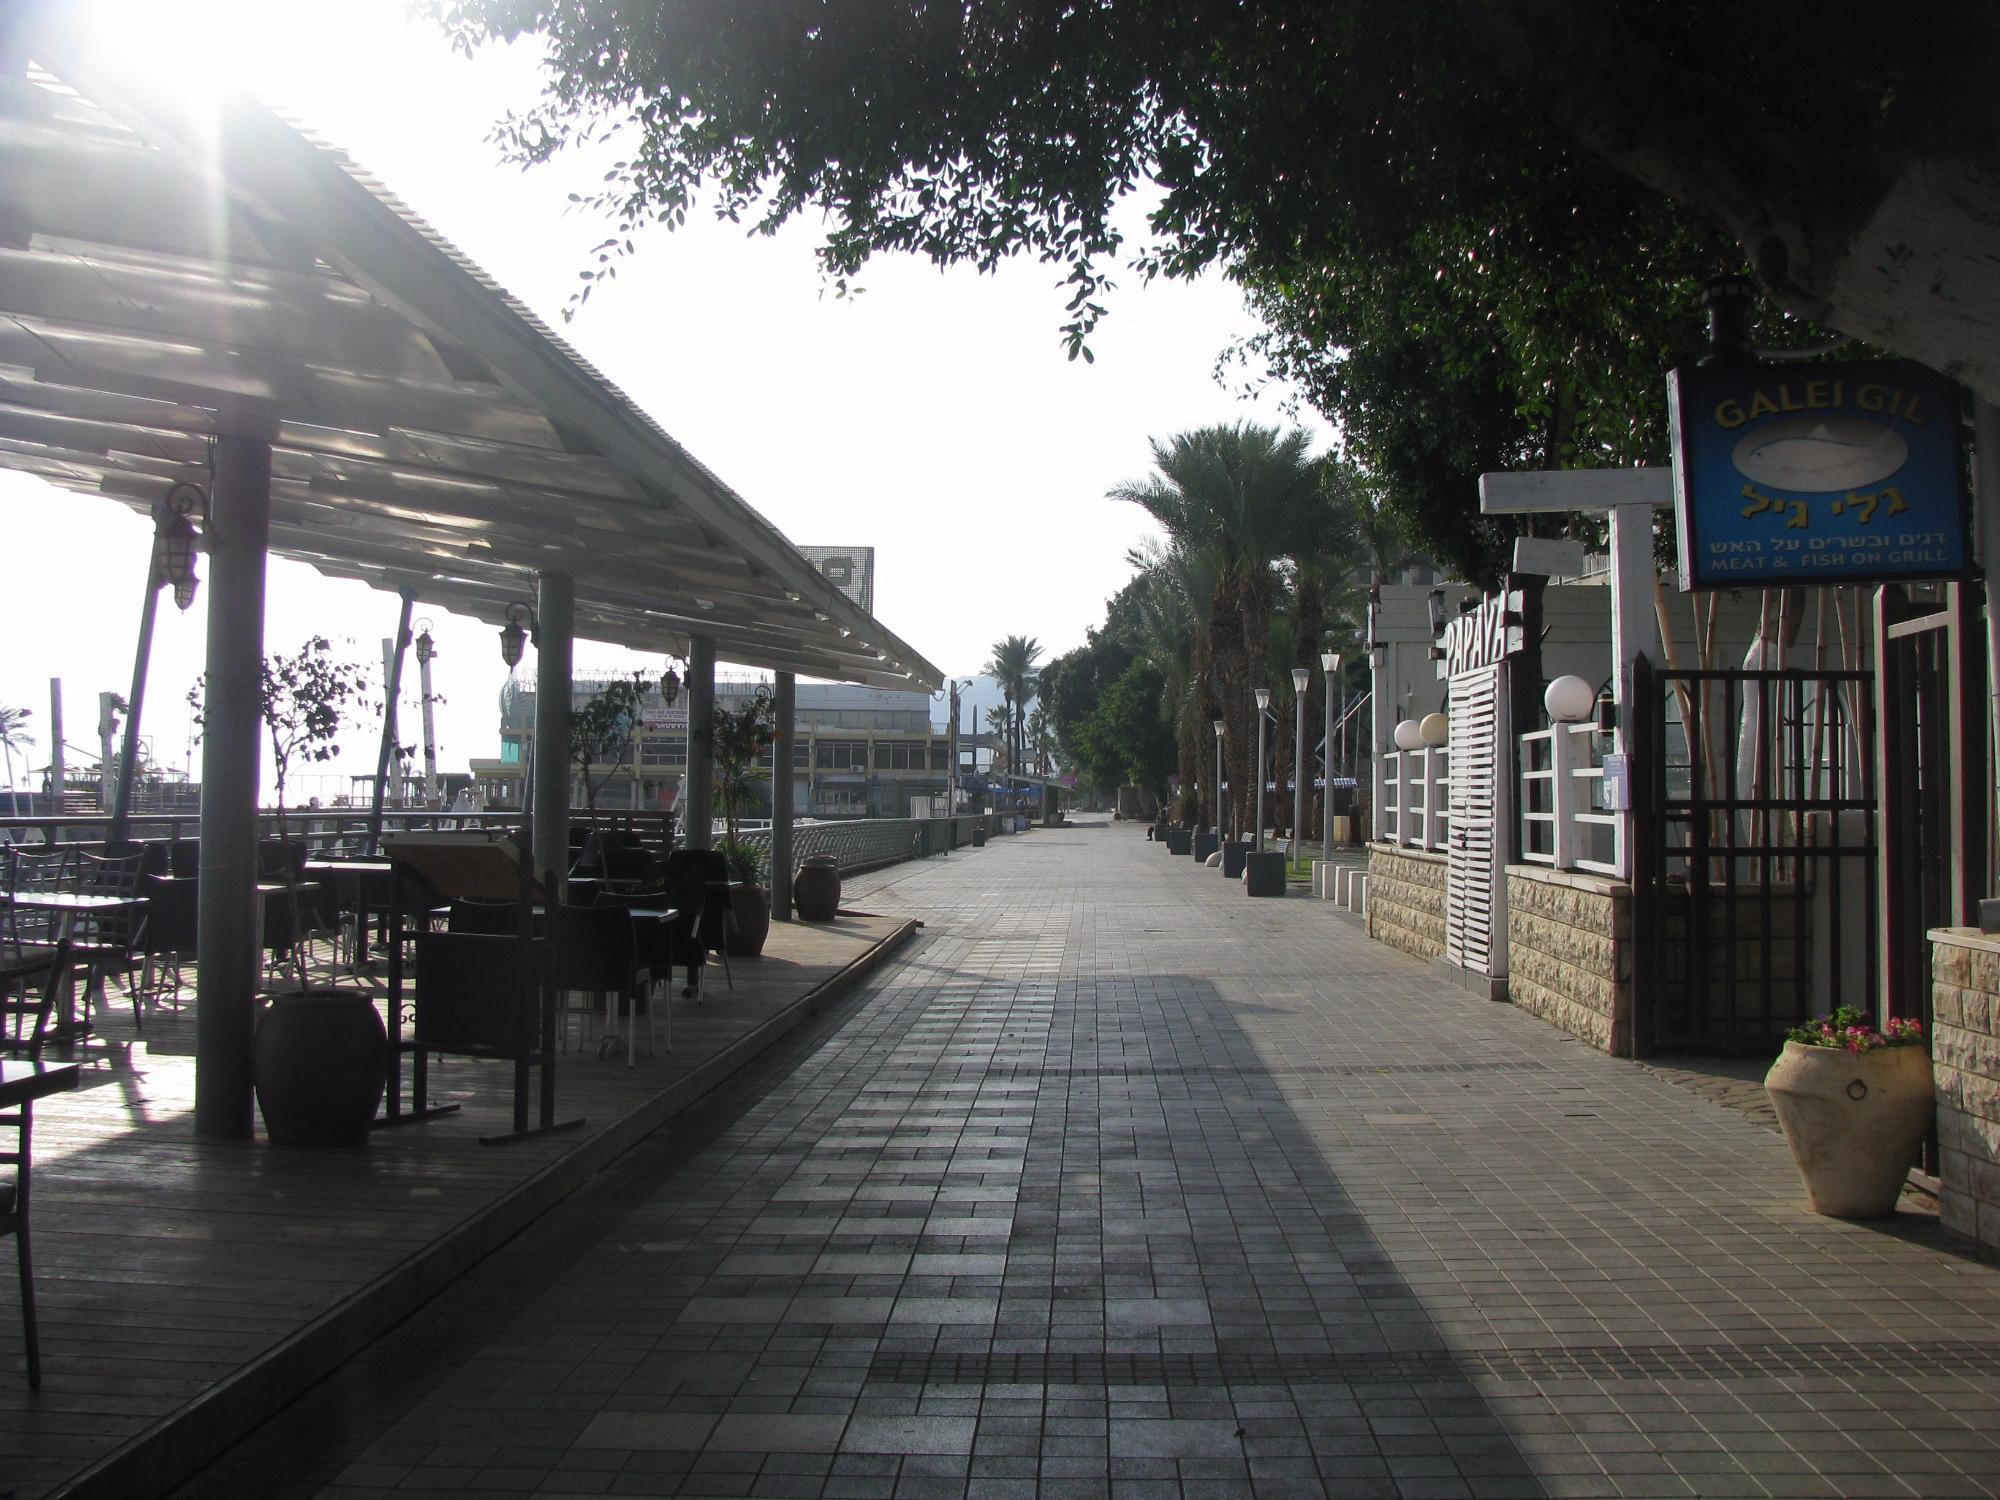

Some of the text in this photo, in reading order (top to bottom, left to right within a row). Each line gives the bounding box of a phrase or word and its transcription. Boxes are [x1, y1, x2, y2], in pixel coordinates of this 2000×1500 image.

[1714, 380, 1926, 430] GALEI GIL
[1740, 484, 1909, 529] גלי גיל
[1710, 531, 1947, 554] דגים ובשרים על האש
[1711, 549, 1947, 571] MEAT & FISH ON GRILL
[1446, 590, 1506, 680] PAPAYA
